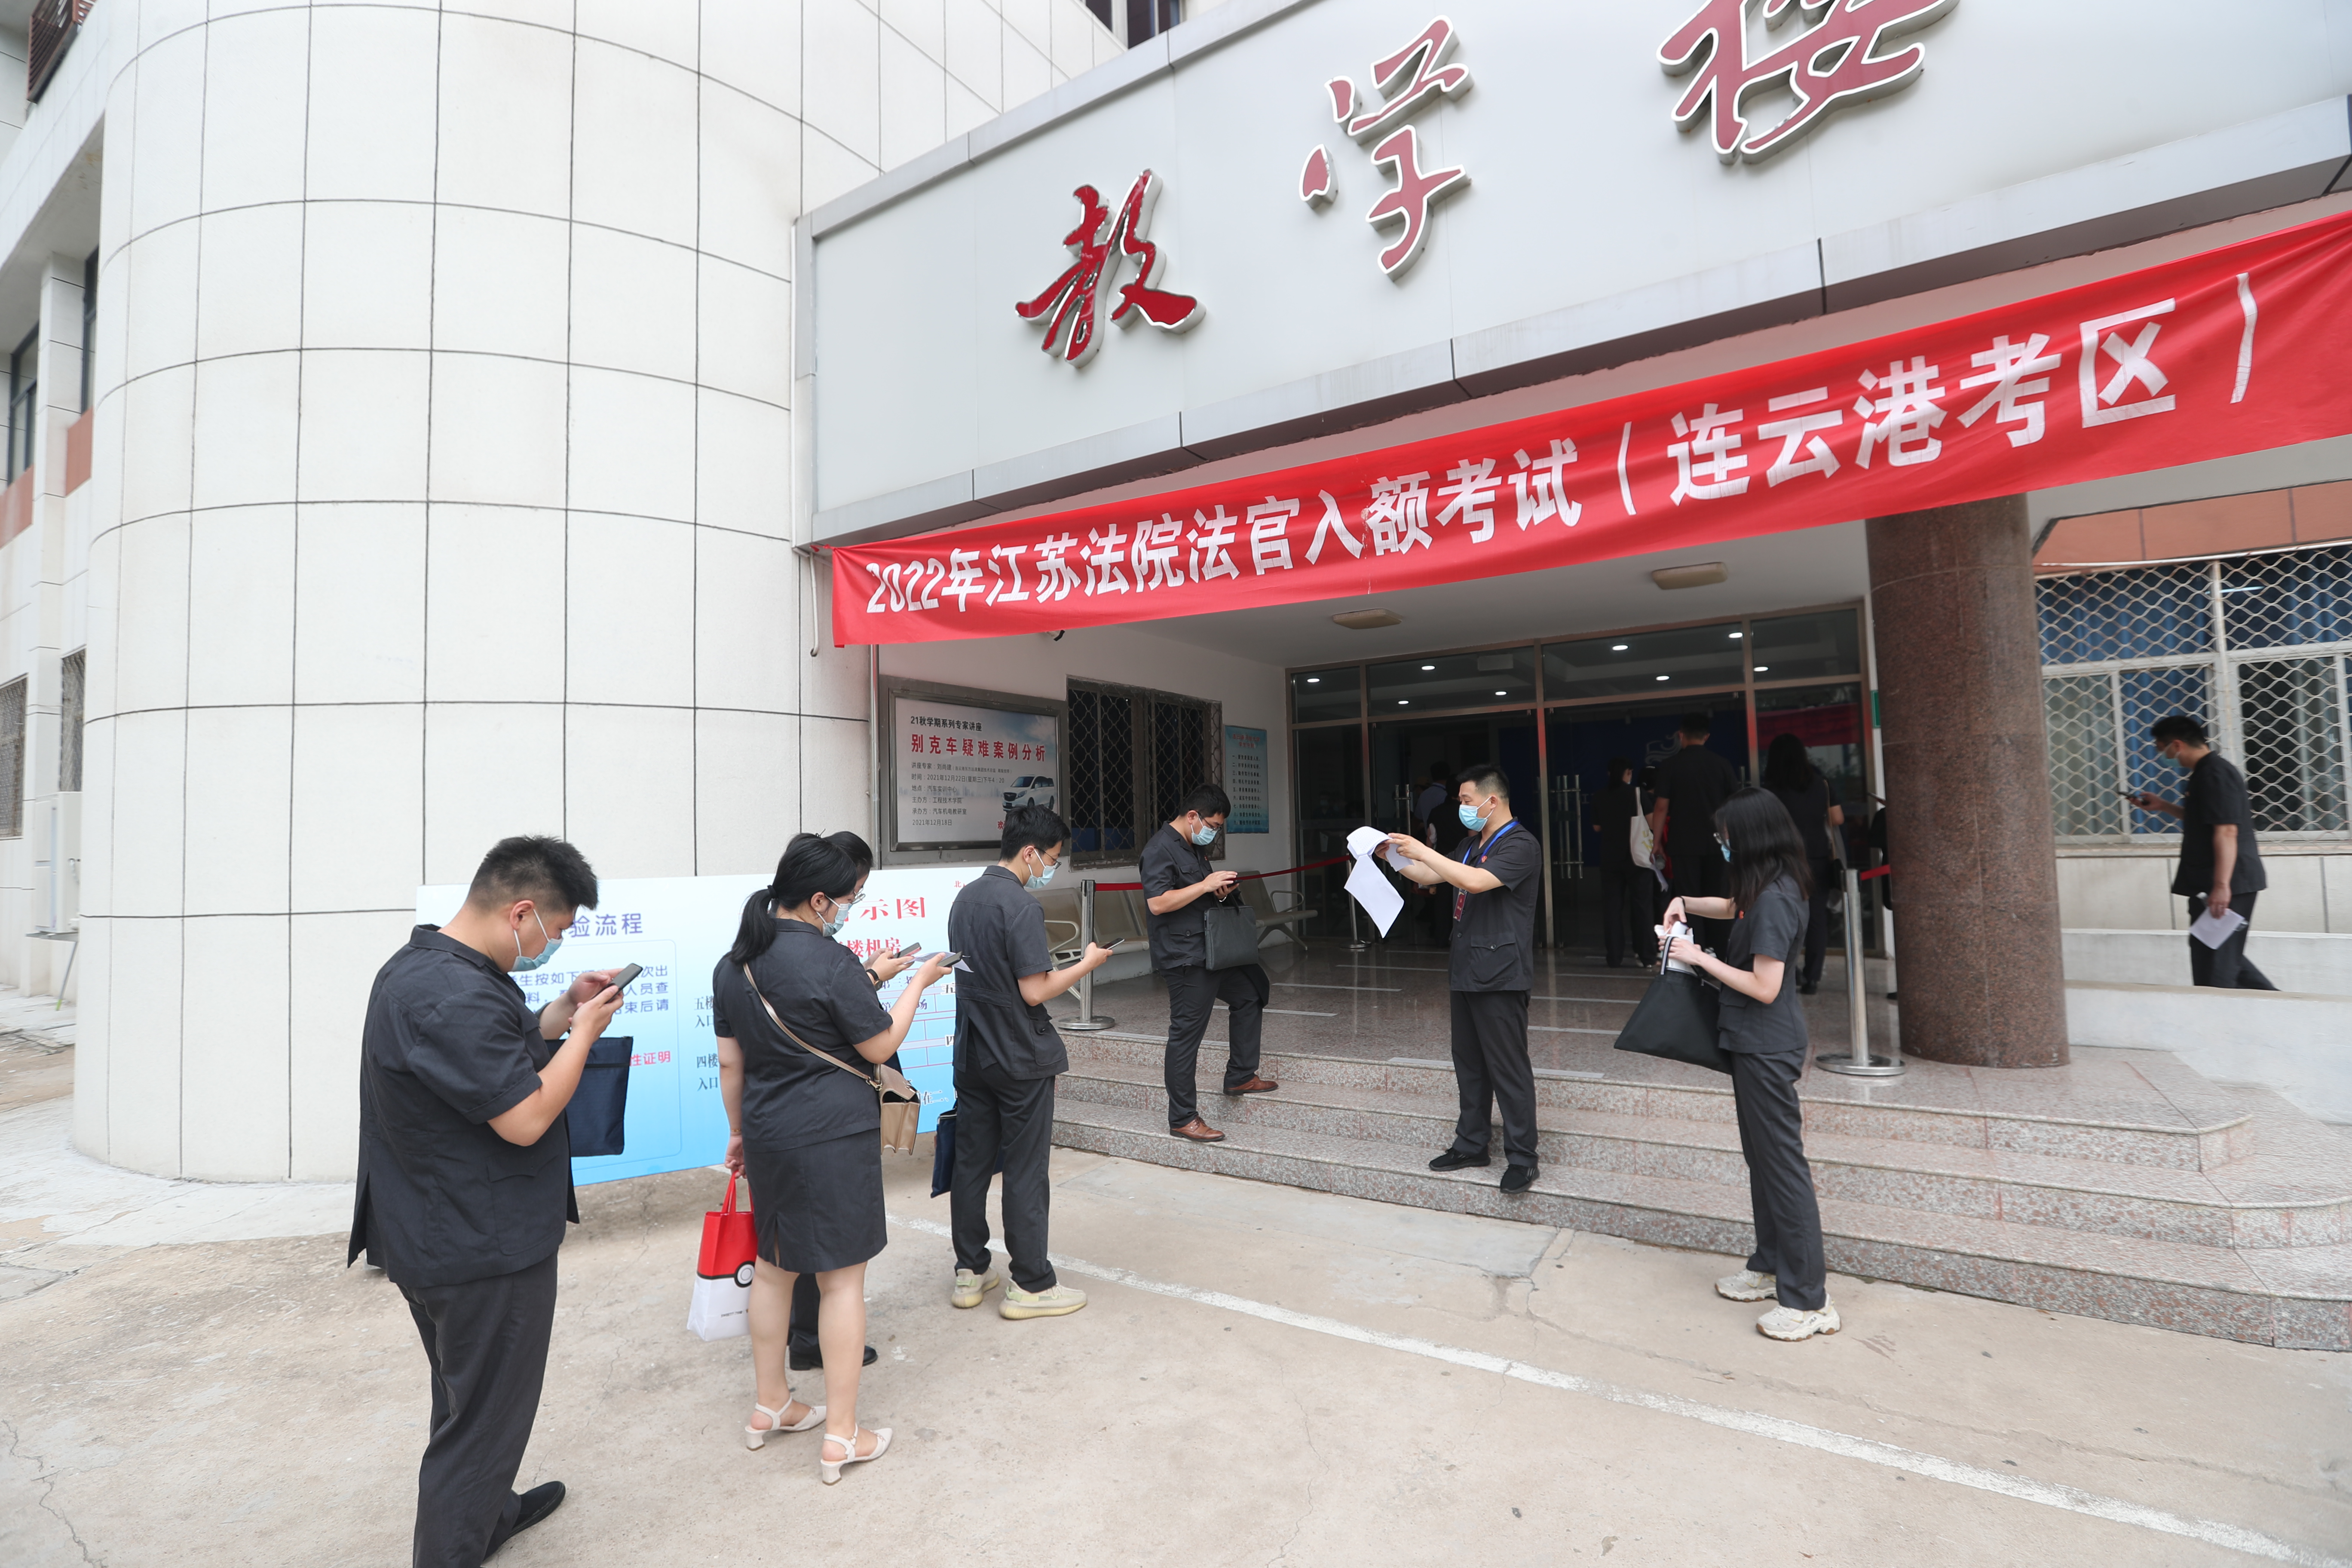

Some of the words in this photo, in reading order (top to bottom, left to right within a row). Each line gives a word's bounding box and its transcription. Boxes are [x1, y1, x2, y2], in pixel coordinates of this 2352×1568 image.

[910, 716, 982, 732] 21秋学期系列专家讲座
[911, 734, 1045, 762] 别克车疑难案例分析
[912, 785, 957, 793] 地点：汽车实训中心
[997, 820, 1006, 830] 欢
[844, 897, 926, 922] 示图
[567, 913, 643, 938] 验流程
[839, 937, 901, 958] 楼机房
[511, 970, 581, 986] 生按如下
[630, 1050, 671, 1067] 性证明
[697, 1077, 718, 1092] 入口
